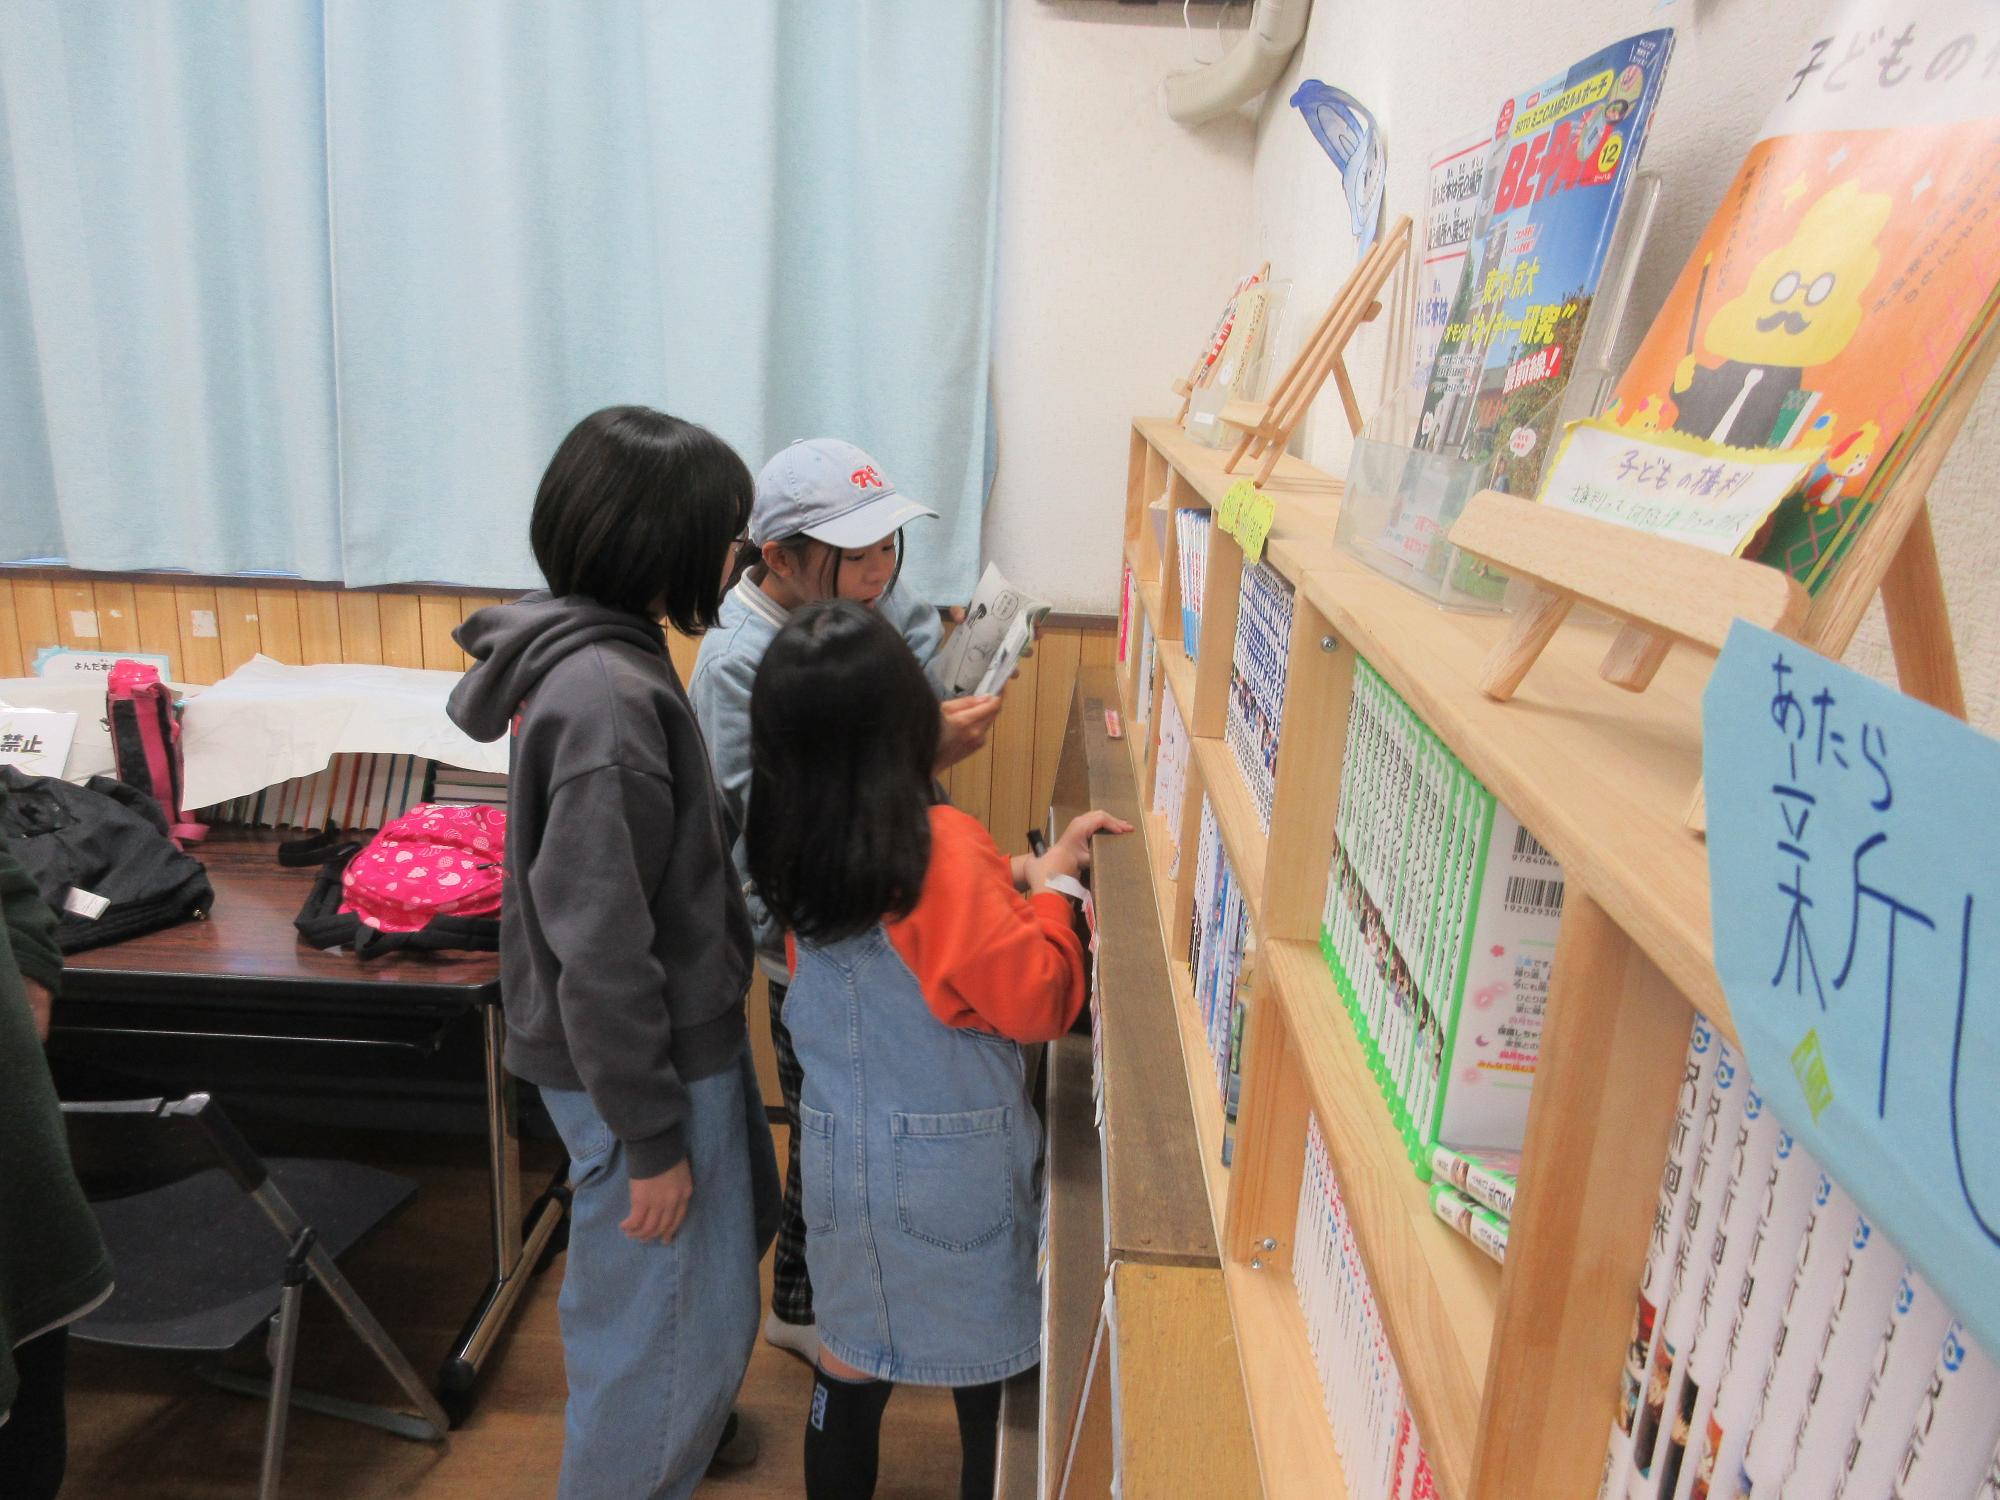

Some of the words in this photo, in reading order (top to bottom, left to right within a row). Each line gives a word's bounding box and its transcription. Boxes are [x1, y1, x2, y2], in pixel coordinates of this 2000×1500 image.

[1785, 23, 2000, 103] 子どもの
[1601, 142, 1619, 164] 12
[0, 733, 43, 753] 禁止
